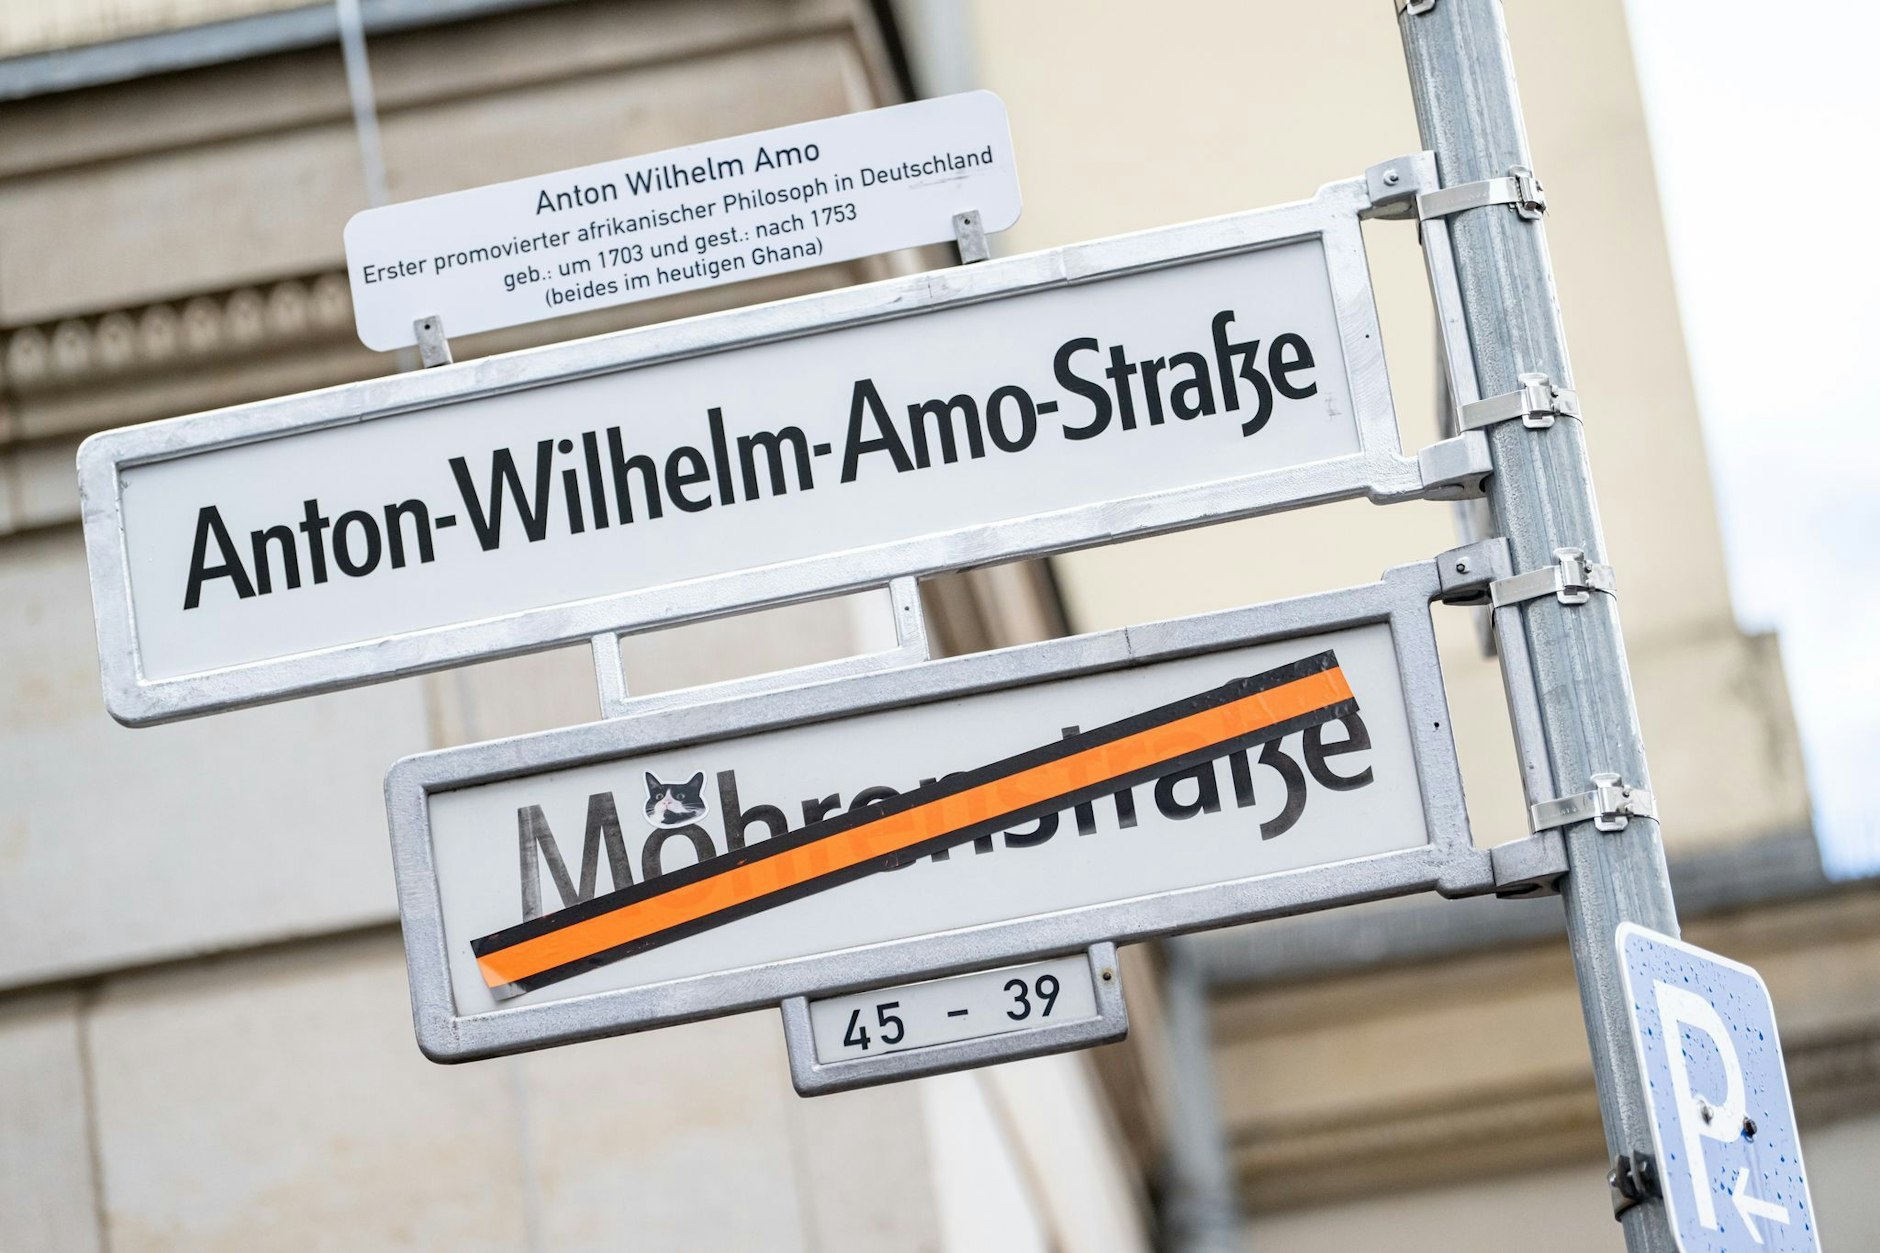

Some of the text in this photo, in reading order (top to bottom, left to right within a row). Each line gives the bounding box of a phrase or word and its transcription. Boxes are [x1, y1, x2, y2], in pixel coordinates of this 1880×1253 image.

[363, 145, 993, 285] Erster promovierter afrikanischer Philosoph in Deutschland
[536, 144, 820, 216] Anton Wilhelm Amo
[503, 203, 857, 293] geb.: um 1703 und gest.: nach 1753
[545, 237, 823, 308] (beides im heutigen Ghana)
[183, 310, 1318, 611] Anton-Wilhelm-Amo-Straße
[843, 974, 1060, 1051] 45 - 39
[1653, 978, 1746, 1232] P
